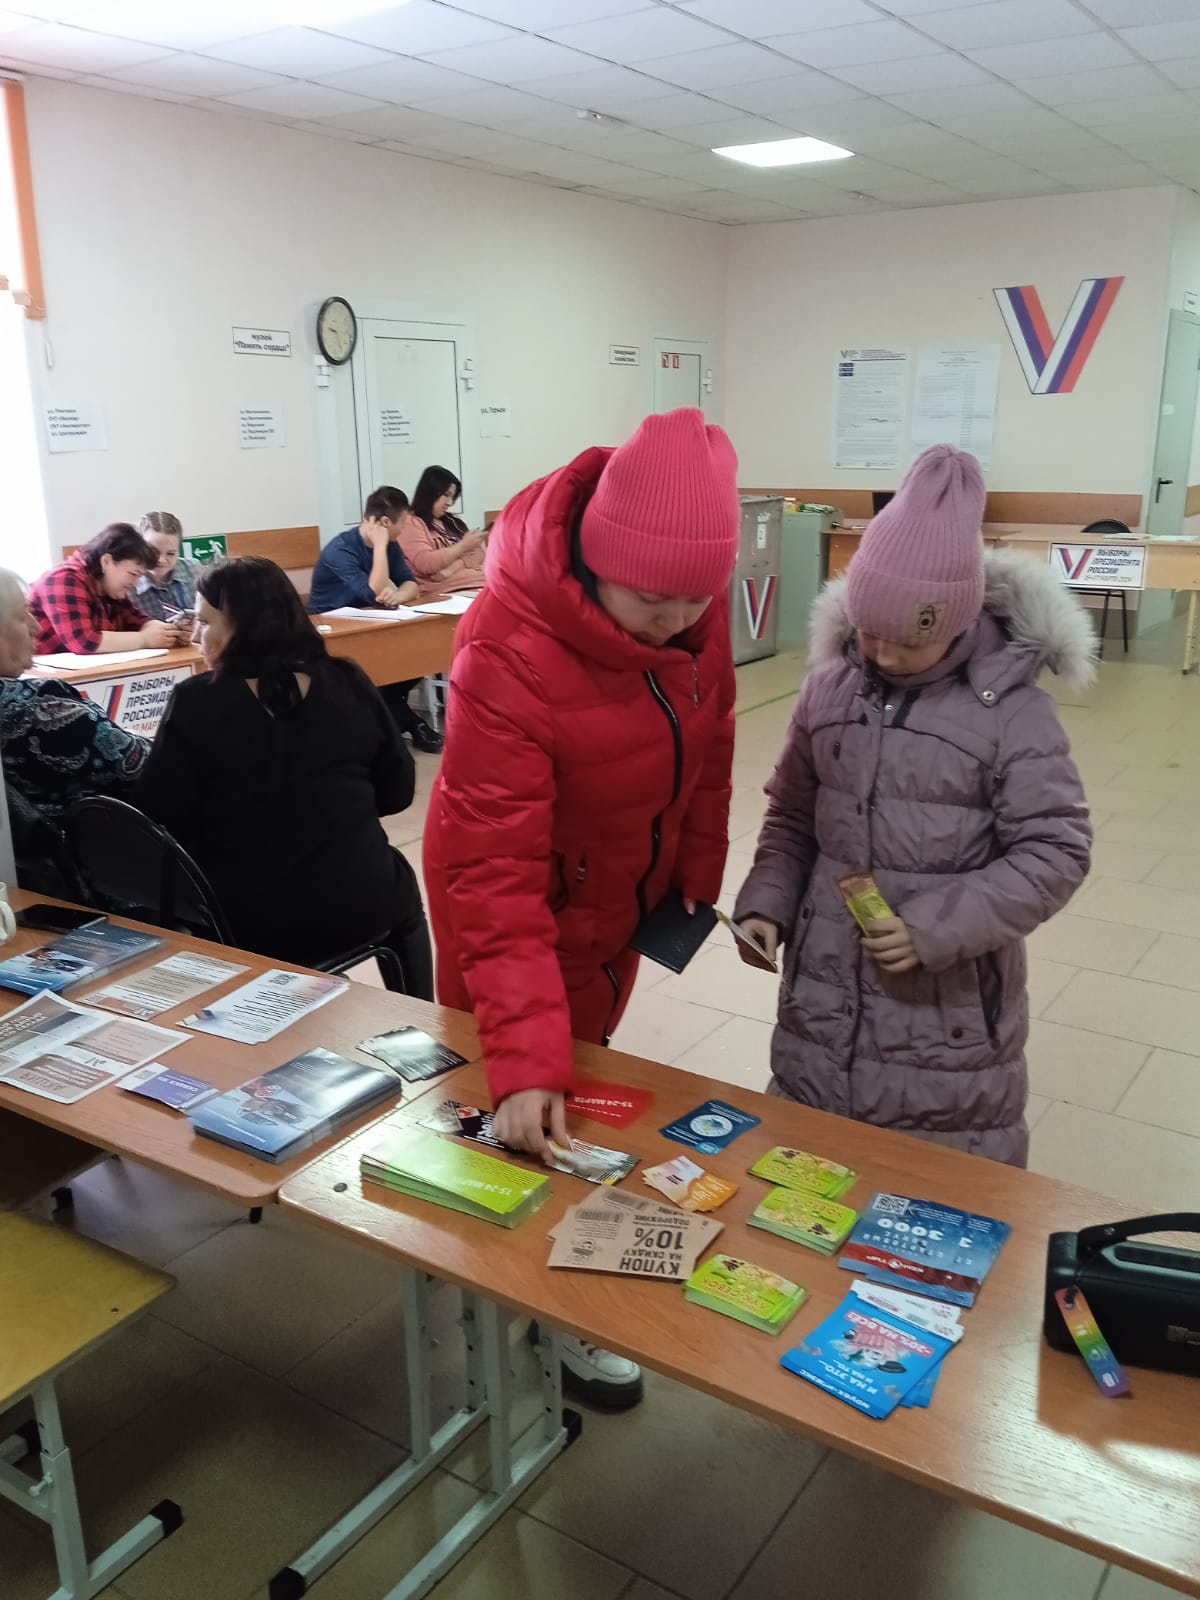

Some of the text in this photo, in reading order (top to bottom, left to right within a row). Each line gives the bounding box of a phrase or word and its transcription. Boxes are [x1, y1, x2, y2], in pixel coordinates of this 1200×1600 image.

[1096, 549, 1131, 557] ВЫБОРЫ
[1091, 557, 1141, 567] ПРЕЗИДЕНТА
[1087, 566, 1119, 574] РОССИИ
[130, 676, 175, 693] ВЫБОРЫ
[122, 706, 164, 723] РОССИИ
[877, 1217, 944, 1241] 3000
[634, 1227, 684, 1250] 10%
[624, 1249, 682, 1261] НА СКИДКУ
[619, 1256, 680, 1275] КУПОН
[878, 1326, 900, 1340] НА
[851, 1369, 866, 1380] НА
[849, 1376, 867, 1390] НА
[867, 1385, 878, 1395] И
